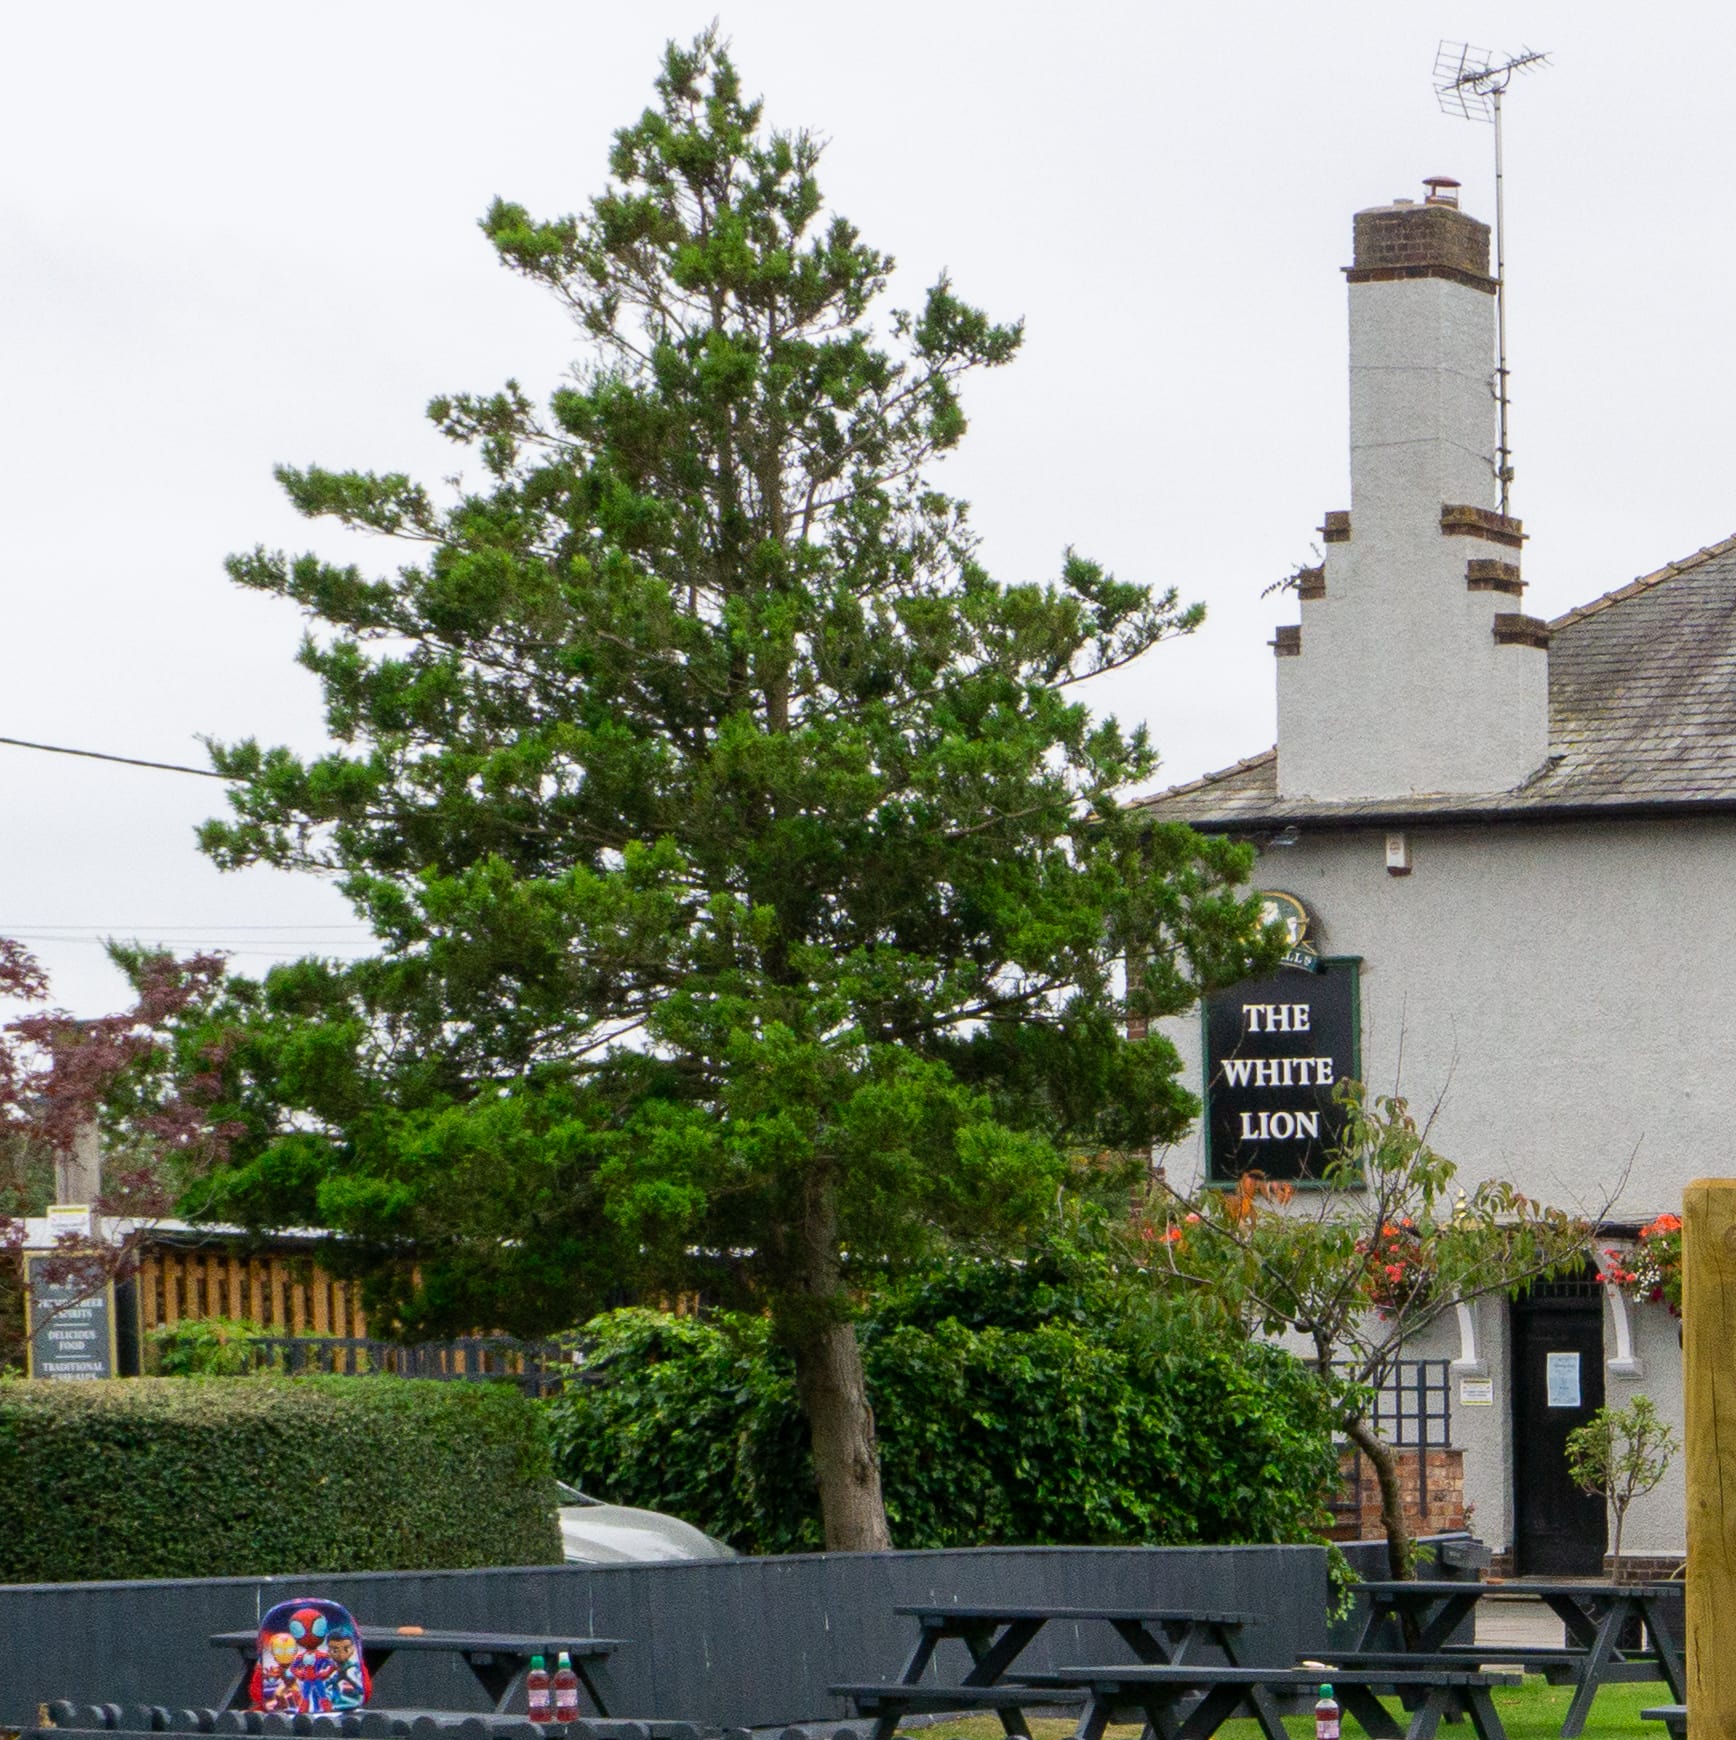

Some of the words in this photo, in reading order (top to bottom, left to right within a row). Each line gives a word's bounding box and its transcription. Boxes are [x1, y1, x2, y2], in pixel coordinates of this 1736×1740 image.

[1243, 1004, 1310, 1032] THE
[1221, 1057, 1333, 1088] WHITE
[1240, 1111, 1320, 1140] LION
[48, 1330, 96, 1340] DELICIOUS
[59, 1341, 86, 1351] FOOD
[43, 1362, 104, 1372] TRADITIONAL
